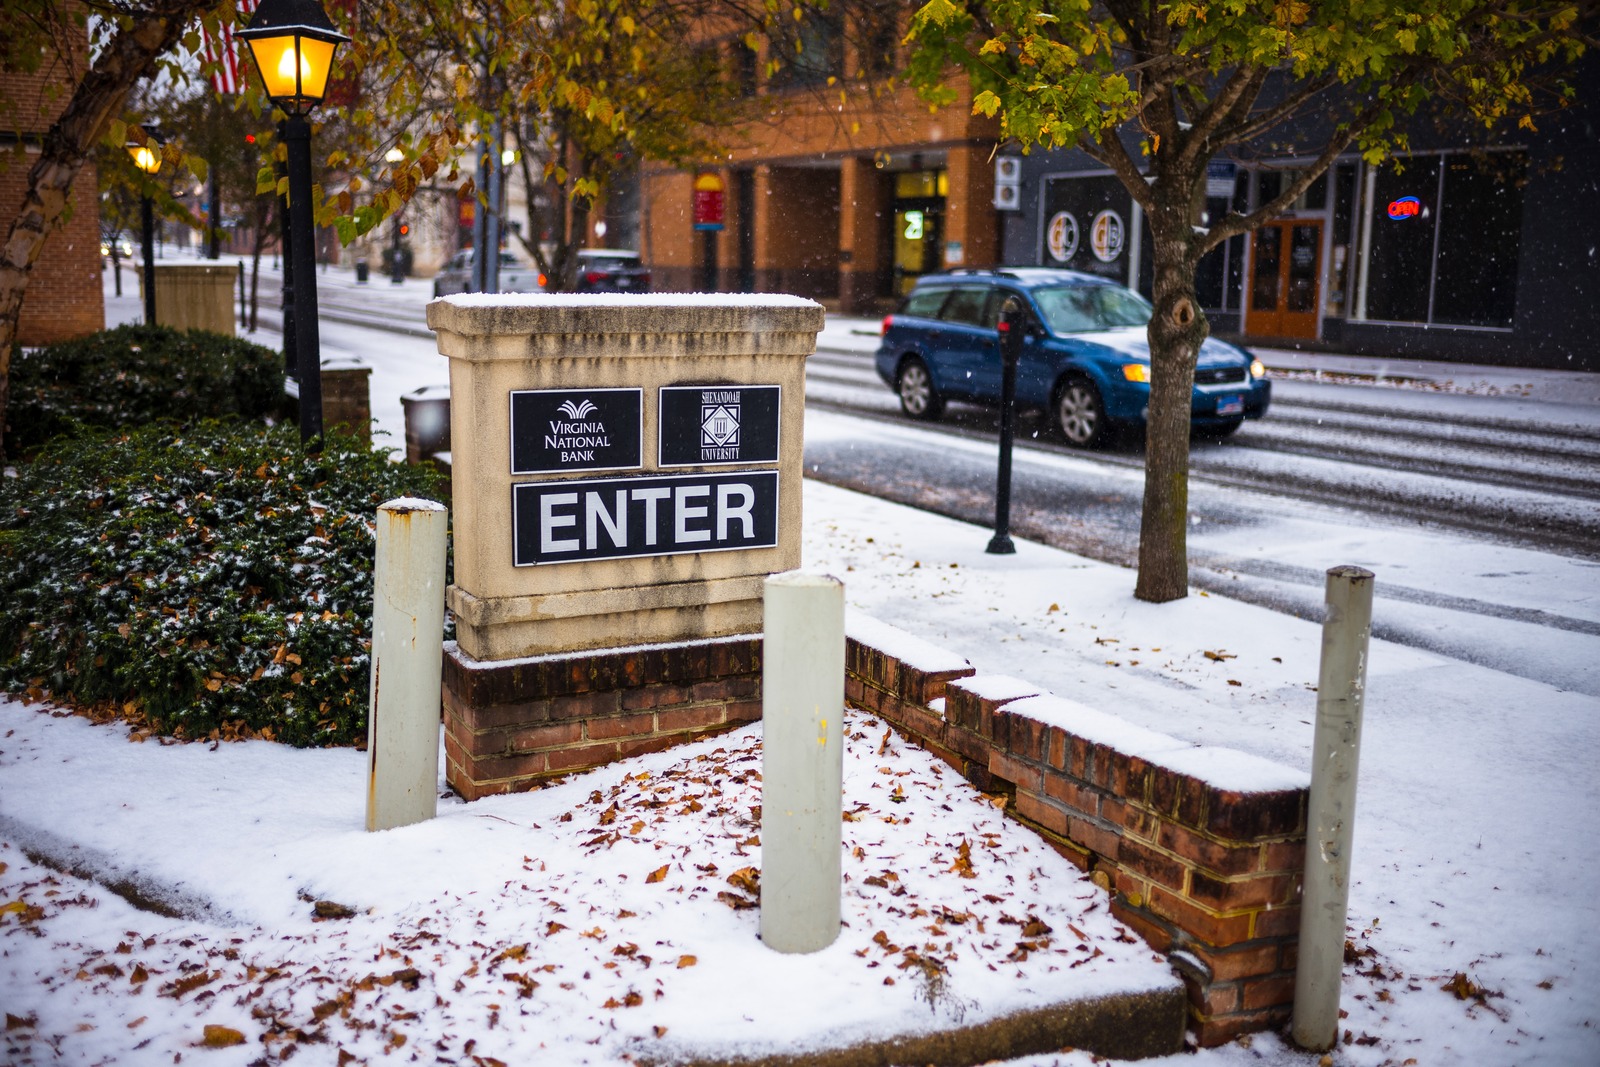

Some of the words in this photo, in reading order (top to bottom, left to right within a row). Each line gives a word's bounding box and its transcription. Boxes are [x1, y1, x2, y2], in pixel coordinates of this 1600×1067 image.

[1387, 201, 1420, 217] OPEN
[701, 391, 741, 404] SHENANDOAH
[549, 420, 605, 435] VIRGINIA
[544, 435, 611, 449] NATIONAL
[561, 450, 595, 462] BANK
[701, 447, 740, 461] UNIVERSITY
[540, 483, 756, 554] ENTER
